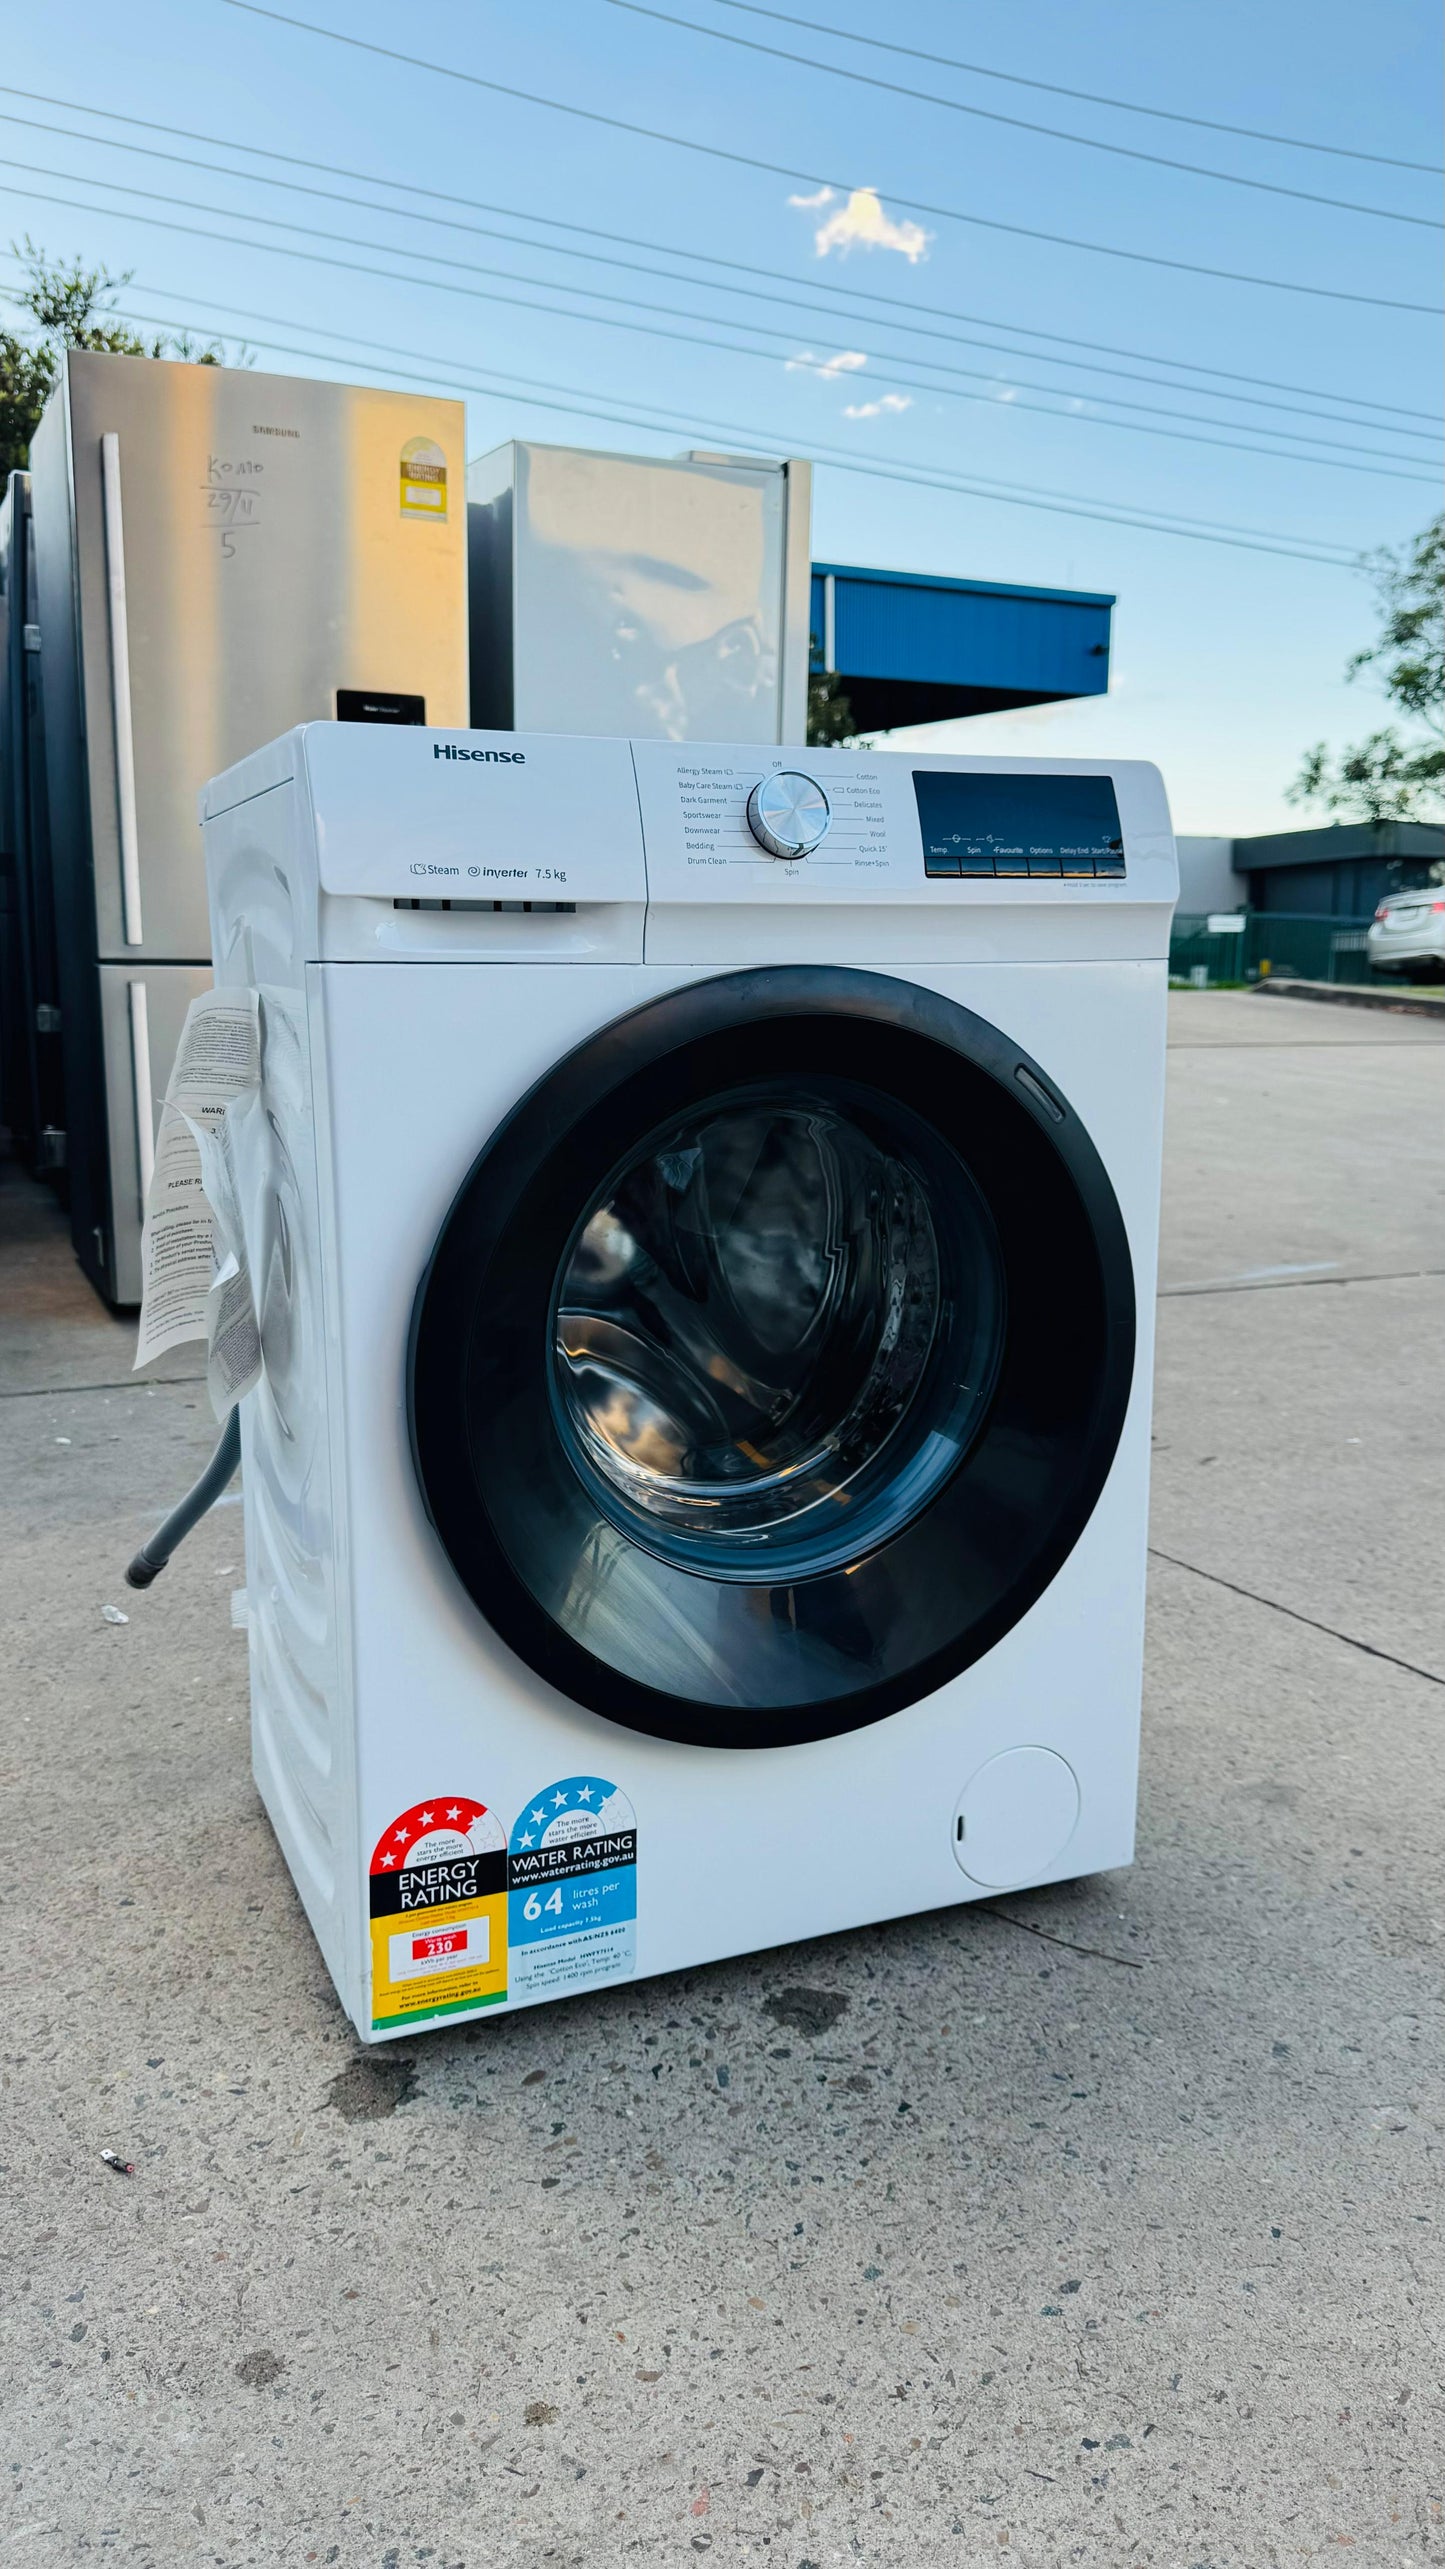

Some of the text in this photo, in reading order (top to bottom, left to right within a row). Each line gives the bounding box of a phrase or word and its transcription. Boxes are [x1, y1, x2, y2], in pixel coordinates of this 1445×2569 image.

[253, 425, 300, 438] SAMSUNG
[221, 531, 236, 559] 5
[433, 743, 526, 765] Hisense
[772, 760, 782, 768] Off
[677, 767, 700, 776] Allergy
[678, 781, 695, 790] Baby
[711, 782, 733, 790] Steam
[698, 796, 727, 804] Garment
[683, 811, 721, 819] Sportswear
[684, 826, 720, 834] Downwear
[686, 842, 715, 851] Bedding
[859, 845, 877, 853] Quick
[967, 846, 981, 855] Spin
[1029, 846, 1053, 855] Options
[1060, 847, 1076, 855] Delay
[428, 864, 567, 882] Steam inverter 7.5 kg
[784, 868, 799, 876] Spin
[168, 1178, 193, 1188] PLEASE
[571, 1816, 590, 1825] more
[579, 1822, 598, 1831] more
[549, 1829, 597, 1844] water efficient
[438, 1838, 455, 1847] more
[445, 1843, 463, 1851] more
[416, 1848, 464, 1863] energy efficient
[512, 1835, 633, 1873] WATER RATING
[512, 1852, 634, 1885] www.waterrating.gov.au
[399, 1859, 480, 1891] ENERGY
[401, 1879, 478, 1909] RATING
[573, 1881, 620, 1899] litres per
[523, 1887, 563, 1921] 64
[572, 1897, 599, 1911] wash
[412, 1923, 467, 1938] Energy consumption
[540, 1925, 557, 1933] Load
[558, 1919, 583, 1930] capacity
[424, 1933, 457, 1944] Warm wash
[427, 1939, 453, 1956] 230
[529, 1942, 566, 1954] accordance
[568, 1938, 582, 1946] with
[435, 1956, 448, 1964] per
[449, 1954, 459, 1962] year
[514, 1974, 533, 1983] Using
[526, 1982, 541, 1990] Spin
[563, 1971, 579, 1981] 1400
[594, 1962, 621, 1974] program
[411, 1991, 426, 2000] more
